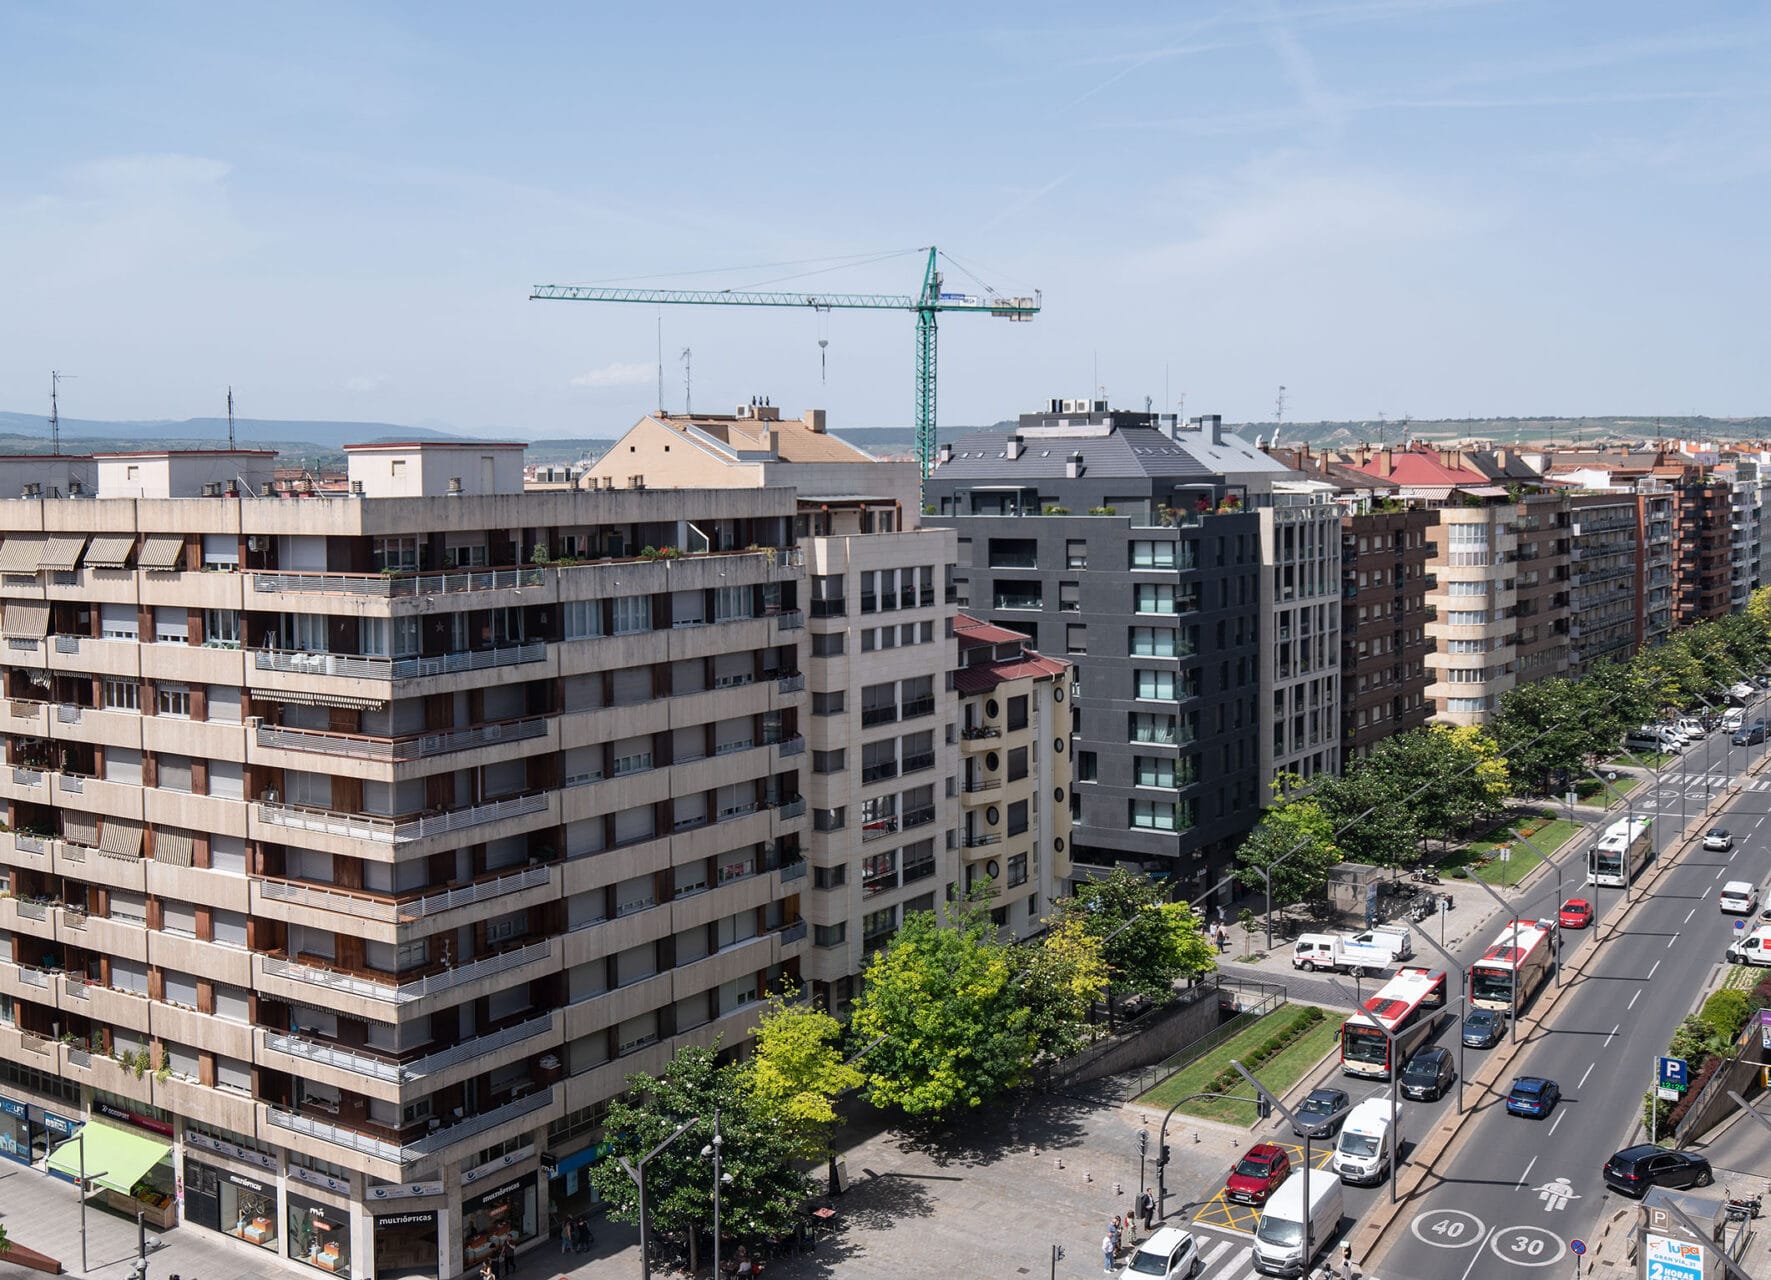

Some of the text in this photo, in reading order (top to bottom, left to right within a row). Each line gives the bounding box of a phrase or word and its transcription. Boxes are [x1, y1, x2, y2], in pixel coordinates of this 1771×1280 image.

[1666, 1061, 1681, 1077] P
[1661, 1081, 1685, 1091] 12:26
[1654, 1211, 1666, 1224] P
[1431, 1219, 1465, 1238] 40
[1511, 1236, 1545, 1256] 30
[1667, 1241, 1700, 1258] lupa
[1650, 1262, 1694, 1280] 2 HORAS
